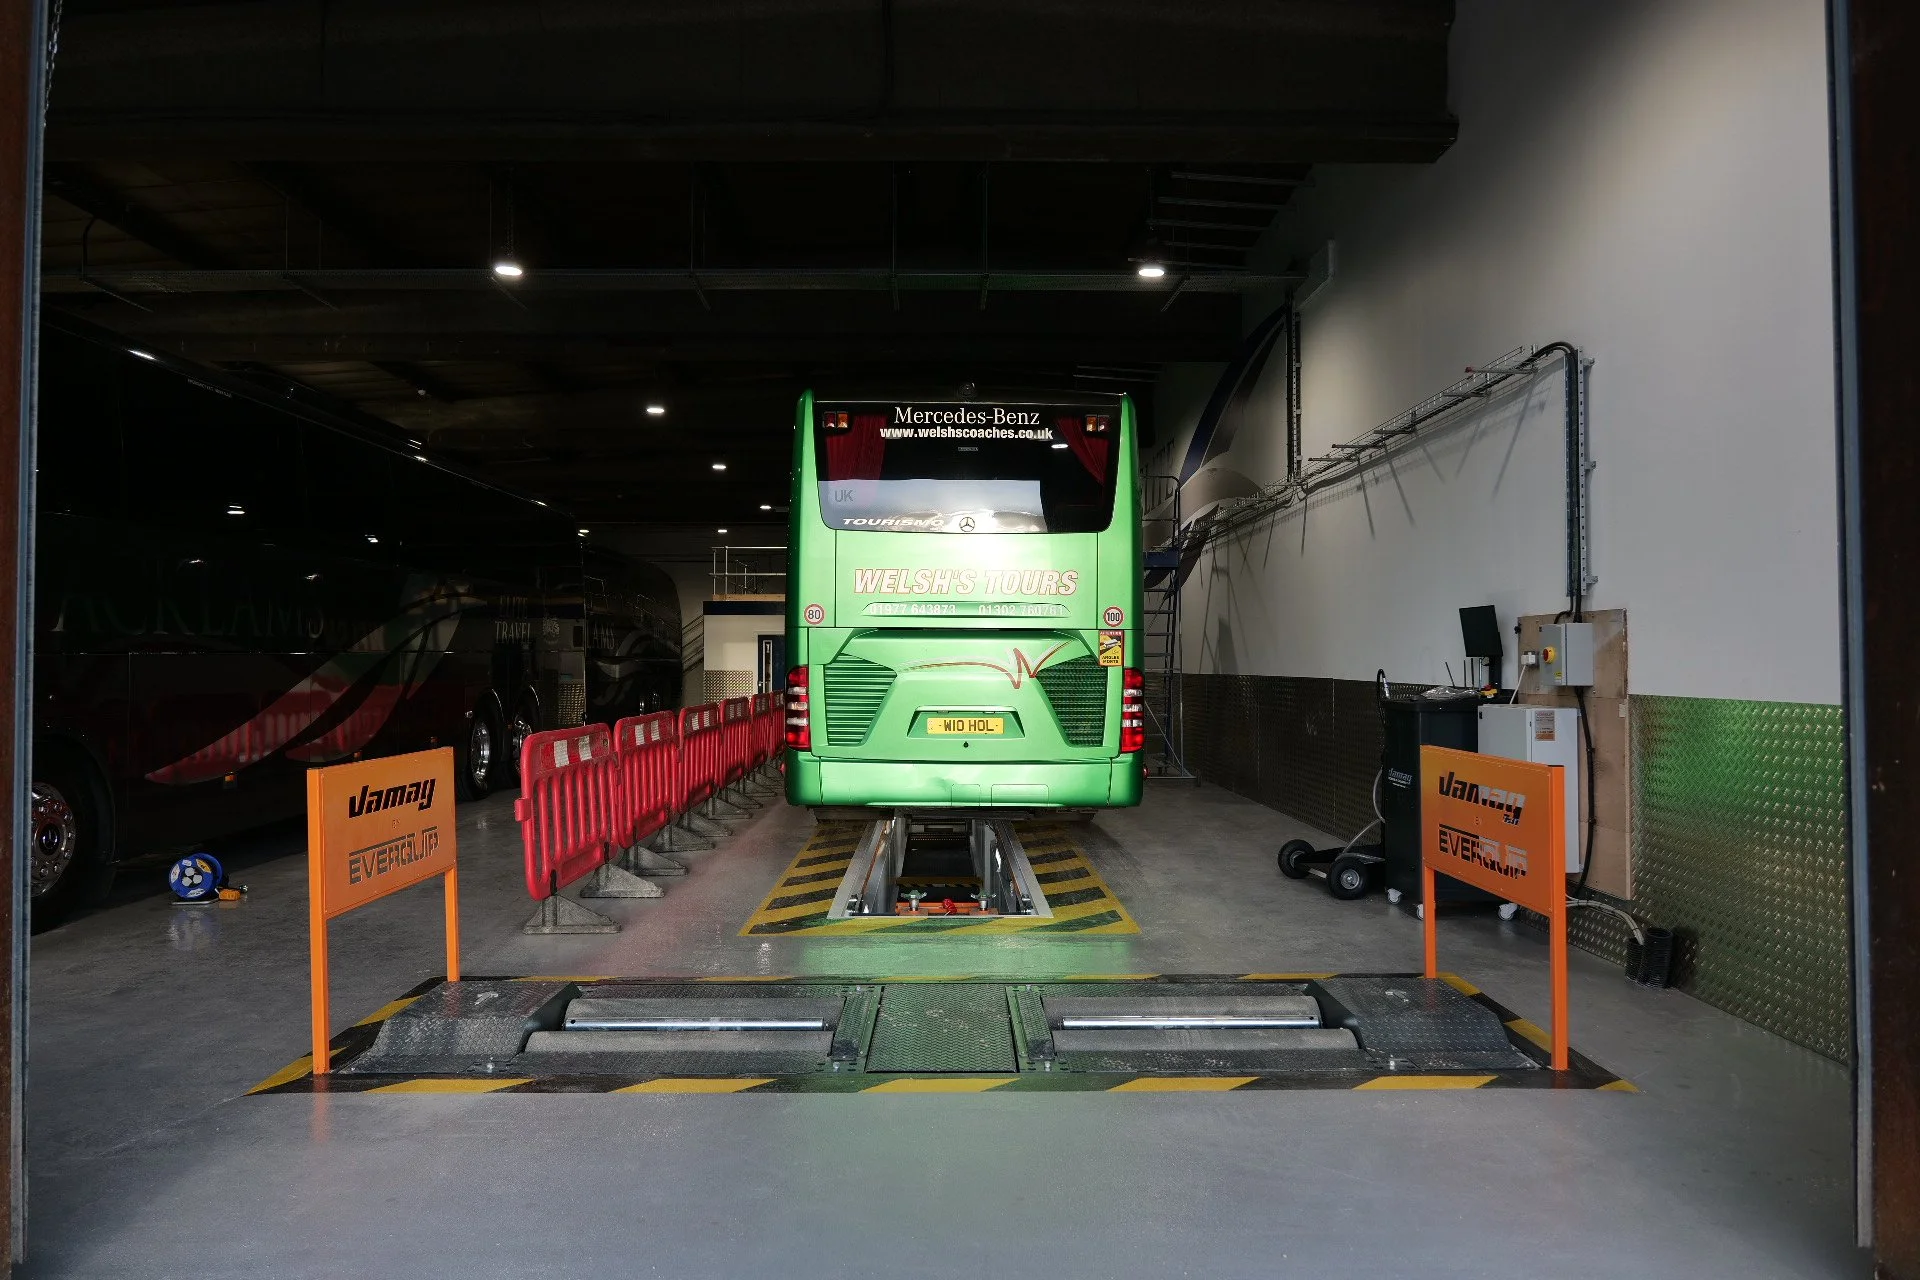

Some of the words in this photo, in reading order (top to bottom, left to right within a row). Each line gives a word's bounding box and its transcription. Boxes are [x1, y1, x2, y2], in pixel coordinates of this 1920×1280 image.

[894, 406, 1040, 425] Mercedes-Benz
[880, 426, 1053, 440] www.welshscoaches.co.uk
[834, 489, 853, 502] UK
[843, 518, 945, 526] TOURISMO
[854, 568, 977, 594] WELSH'S
[983, 569, 1079, 596] TOURS
[808, 609, 821, 619] 80
[869, 603, 908, 615] 01977
[1106, 612, 1120, 622] 100
[968, 719, 994, 731] HOL
[348, 826, 440, 885] EVERQUIP
[1438, 824, 1528, 880] EVERQUIP
